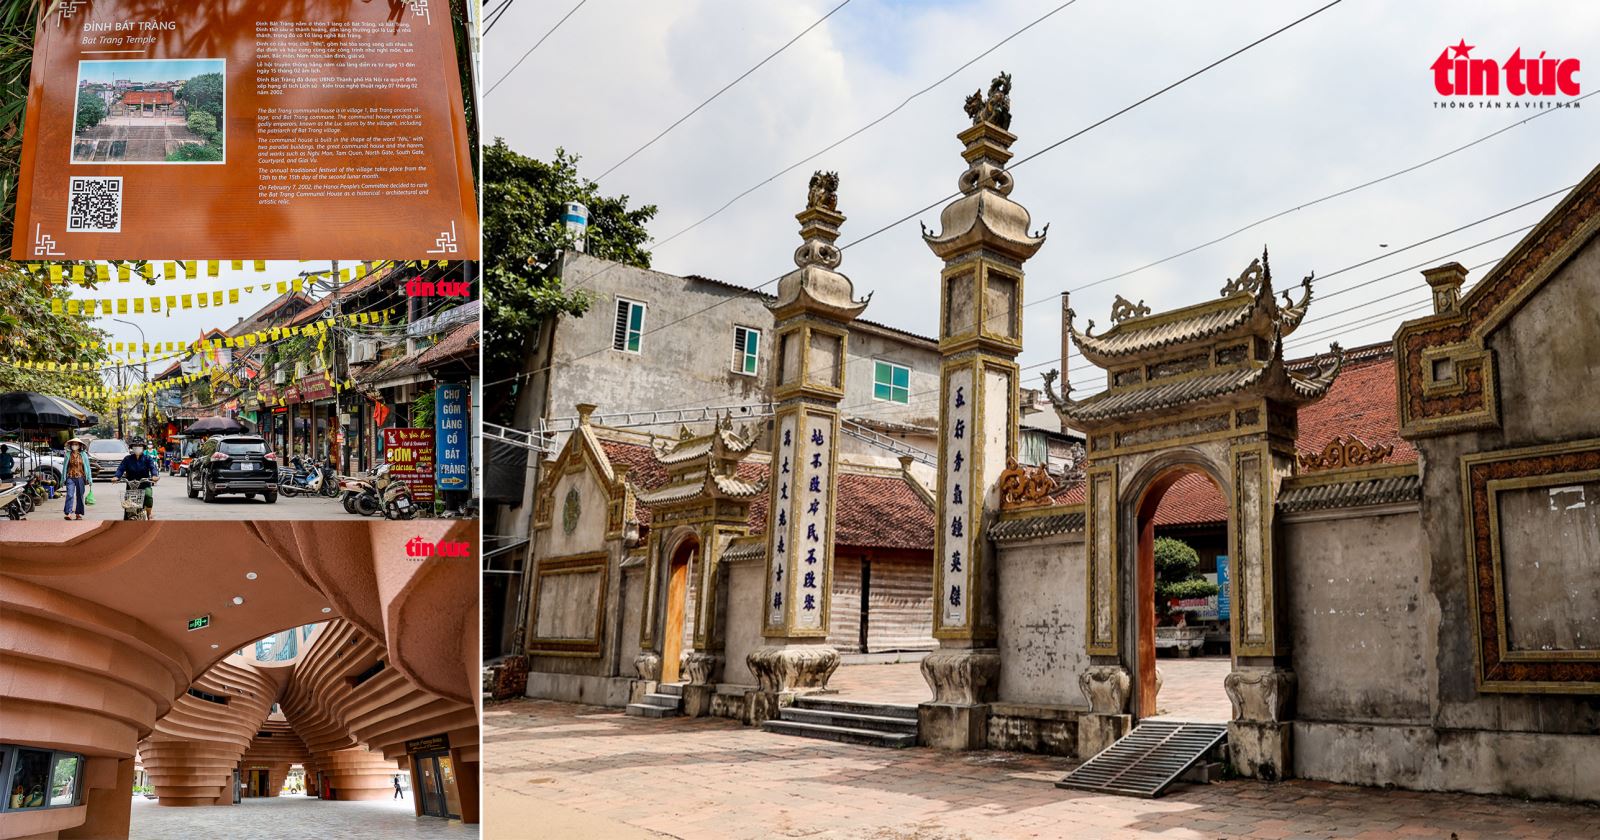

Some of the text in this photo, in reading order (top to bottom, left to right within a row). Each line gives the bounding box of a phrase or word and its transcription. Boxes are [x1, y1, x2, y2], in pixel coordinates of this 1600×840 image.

[83, 19, 176, 32] ĐÌNH BÁT TRÀNG
[82, 35, 156, 46] Bat Trang Temple
[443, 402, 461, 414] GỐM
[442, 418, 462, 430] LÀNG
[447, 432, 458, 444] CỔ
[445, 448, 460, 459] BÁT
[440, 463, 466, 474] TRÀNG
